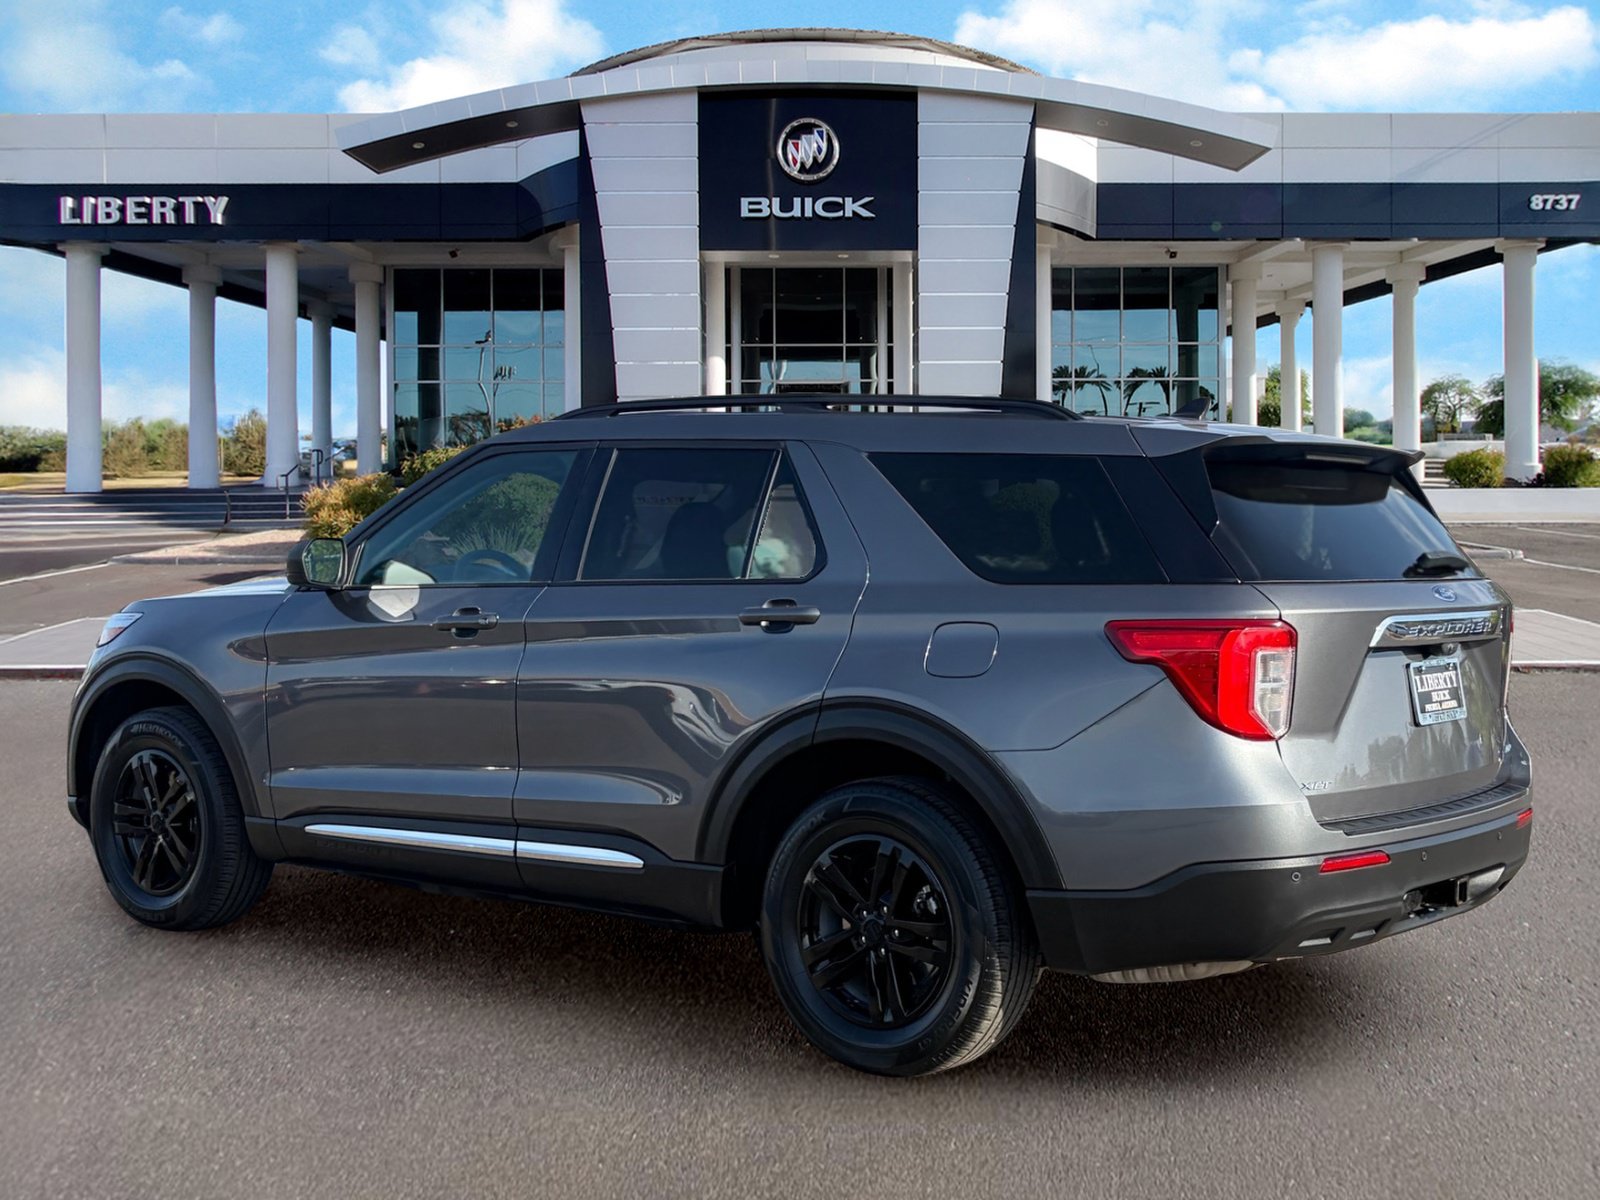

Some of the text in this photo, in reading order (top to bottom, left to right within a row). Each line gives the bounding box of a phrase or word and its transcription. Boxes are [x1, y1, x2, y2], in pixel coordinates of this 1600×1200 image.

[59, 195, 230, 226] LIBERTY
[740, 196, 876, 218] BUICK
[1529, 193, 1581, 211] 8737
[1408, 621, 1493, 637] EXPLORER
[1415, 671, 1458, 692] LIBERTY
